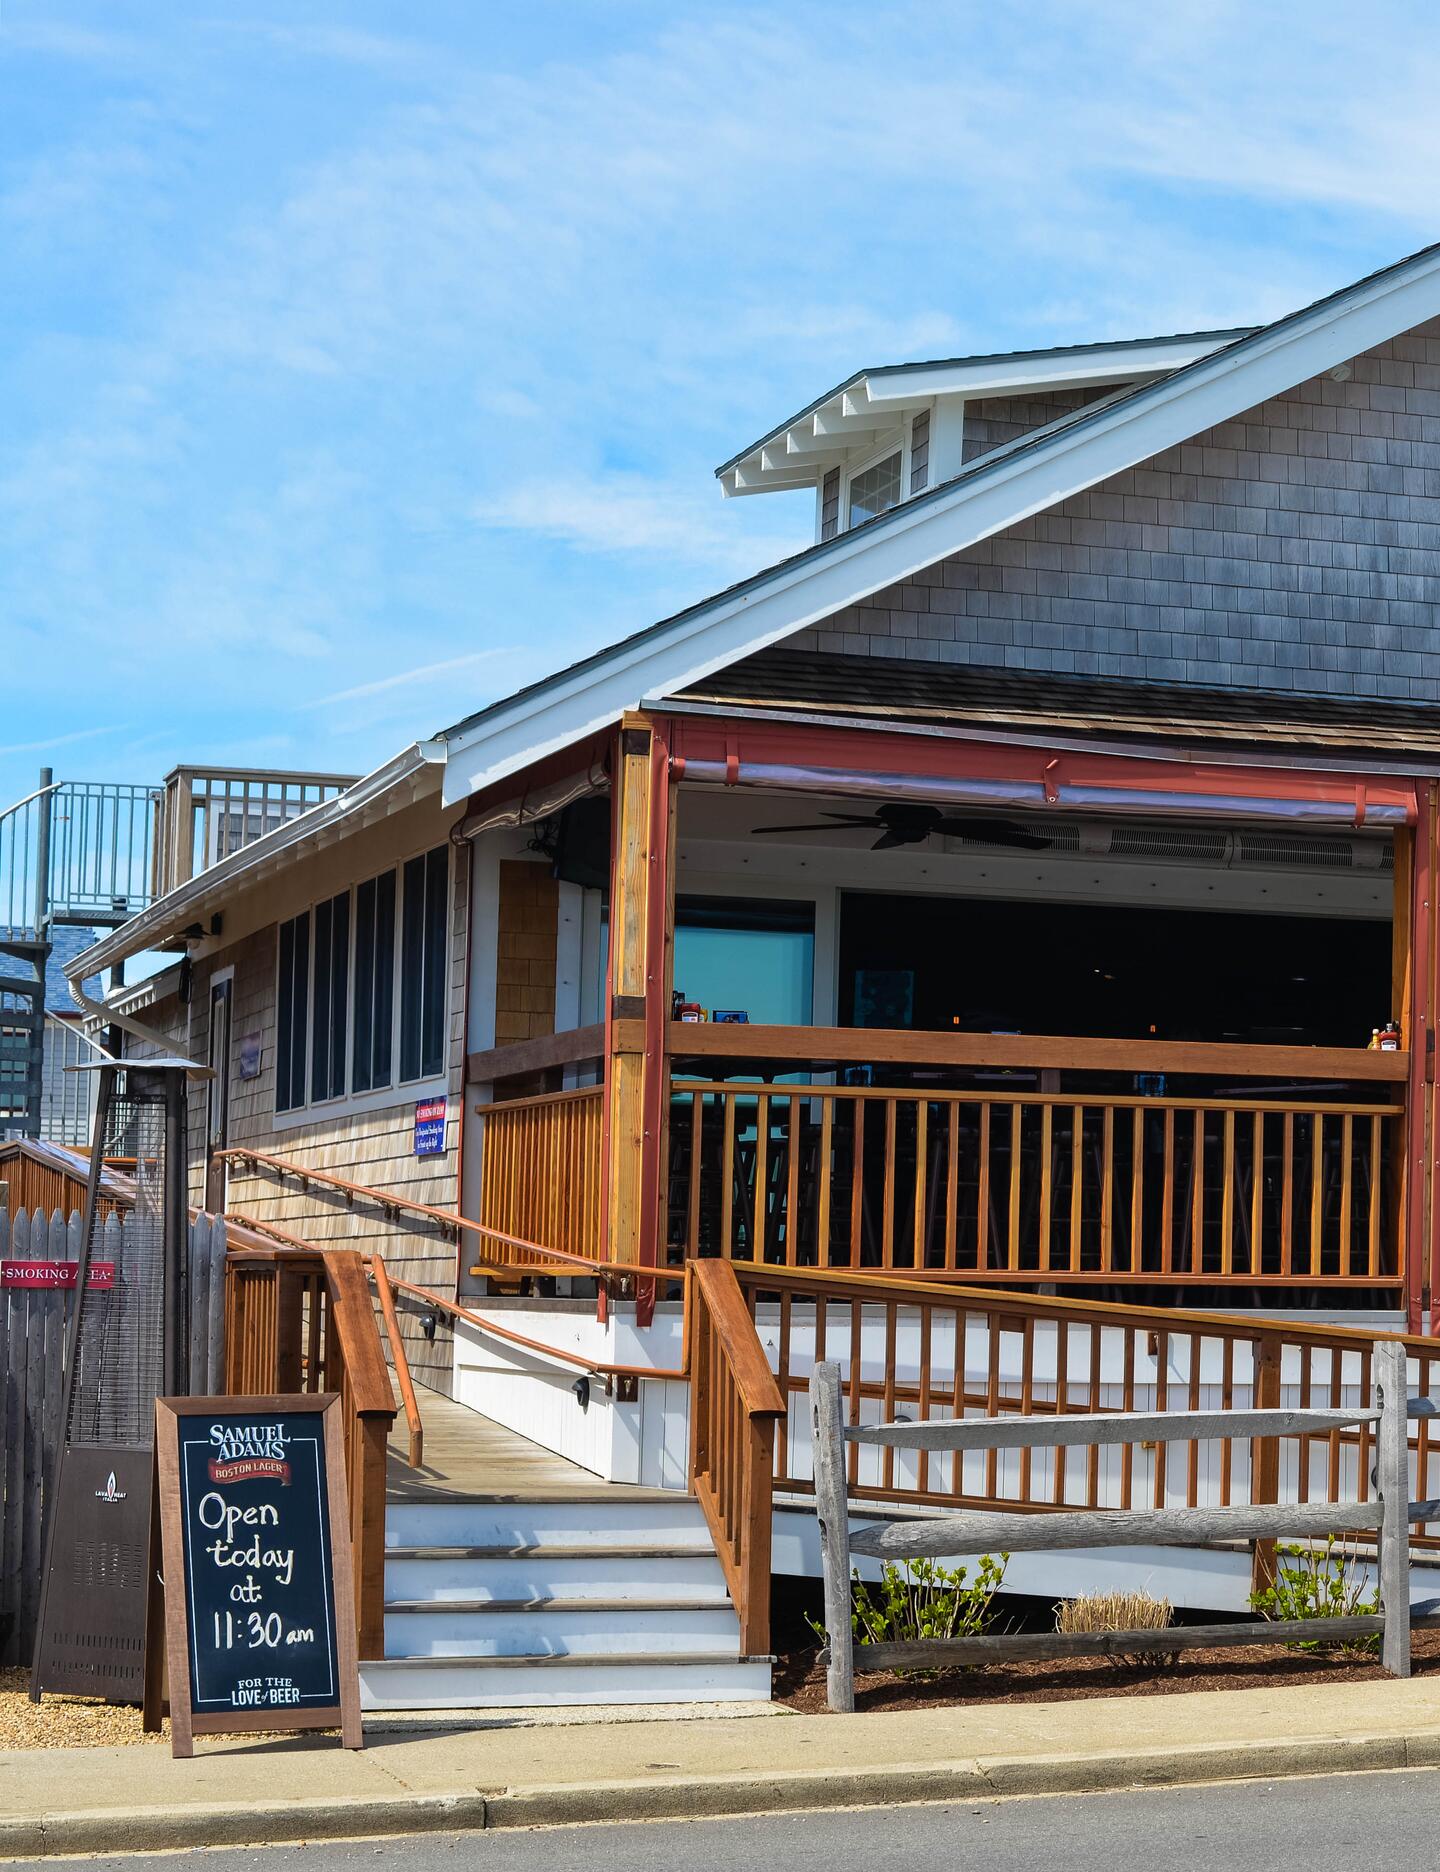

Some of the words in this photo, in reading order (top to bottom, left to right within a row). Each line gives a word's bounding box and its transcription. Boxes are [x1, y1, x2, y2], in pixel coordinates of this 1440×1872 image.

[6, 1268, 69, 1280] SMOKING
[72, 1269, 108, 1280] AEA
[209, 1423, 291, 1446] SAMUEL
[216, 1441, 285, 1464] ADAMS
[215, 1463, 252, 1479] BOSTON
[253, 1462, 283, 1474] LAGER
[199, 1492, 279, 1543] Open
[205, 1534, 294, 1585] today
[230, 1575, 262, 1603] at
[214, 1611, 282, 1649] 11:30
[286, 1628, 314, 1645] am
[237, 1678, 262, 1689] FOR
[265, 1677, 292, 1687] THE
[231, 1689, 261, 1706] LOVE
[261, 1690, 269, 1702] of
[269, 1687, 300, 1704] BEER
